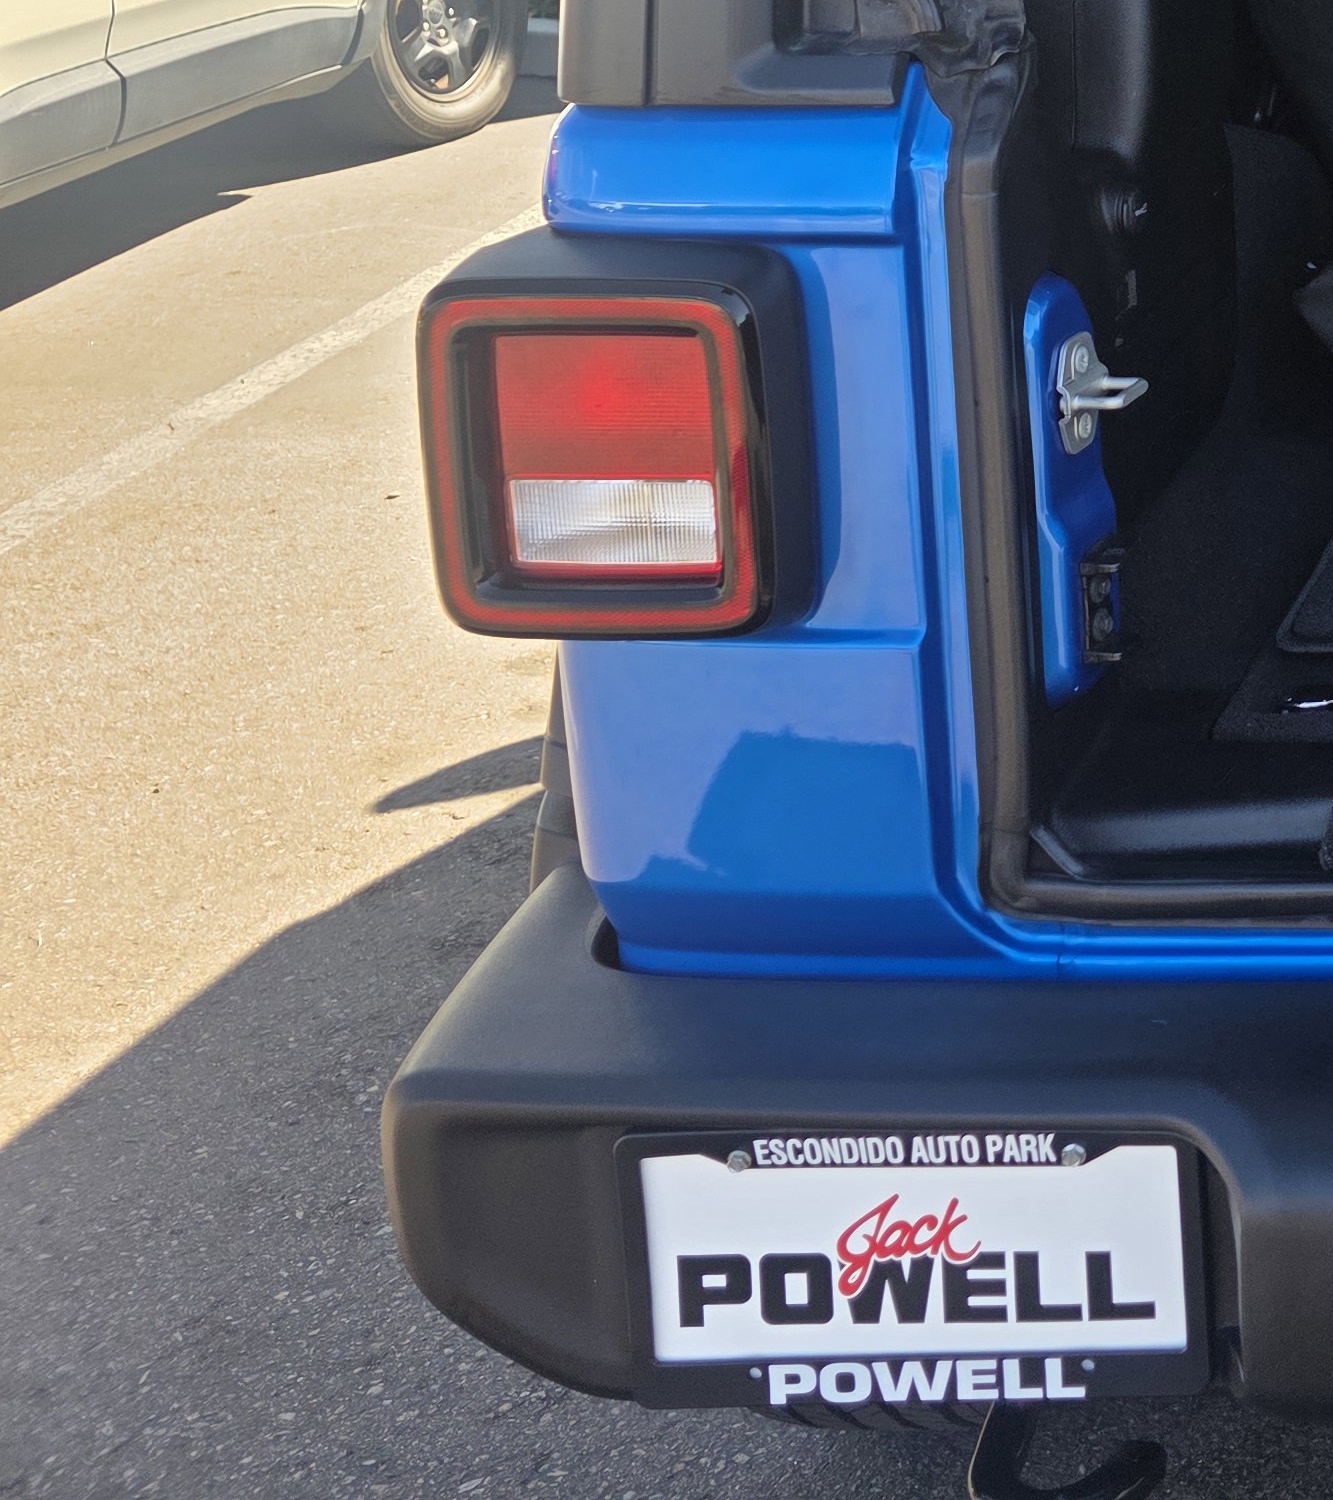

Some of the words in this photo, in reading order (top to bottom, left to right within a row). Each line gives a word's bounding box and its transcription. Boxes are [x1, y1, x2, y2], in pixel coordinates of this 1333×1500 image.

[752, 1136, 904, 1167] ESCONDIDO
[910, 1134, 980, 1165] AUTO
[985, 1132, 1058, 1164] PARK
[836, 1192, 982, 1298] Jack
[675, 1249, 1157, 1329] POWELL
[767, 1356, 1087, 1405] POWELL
